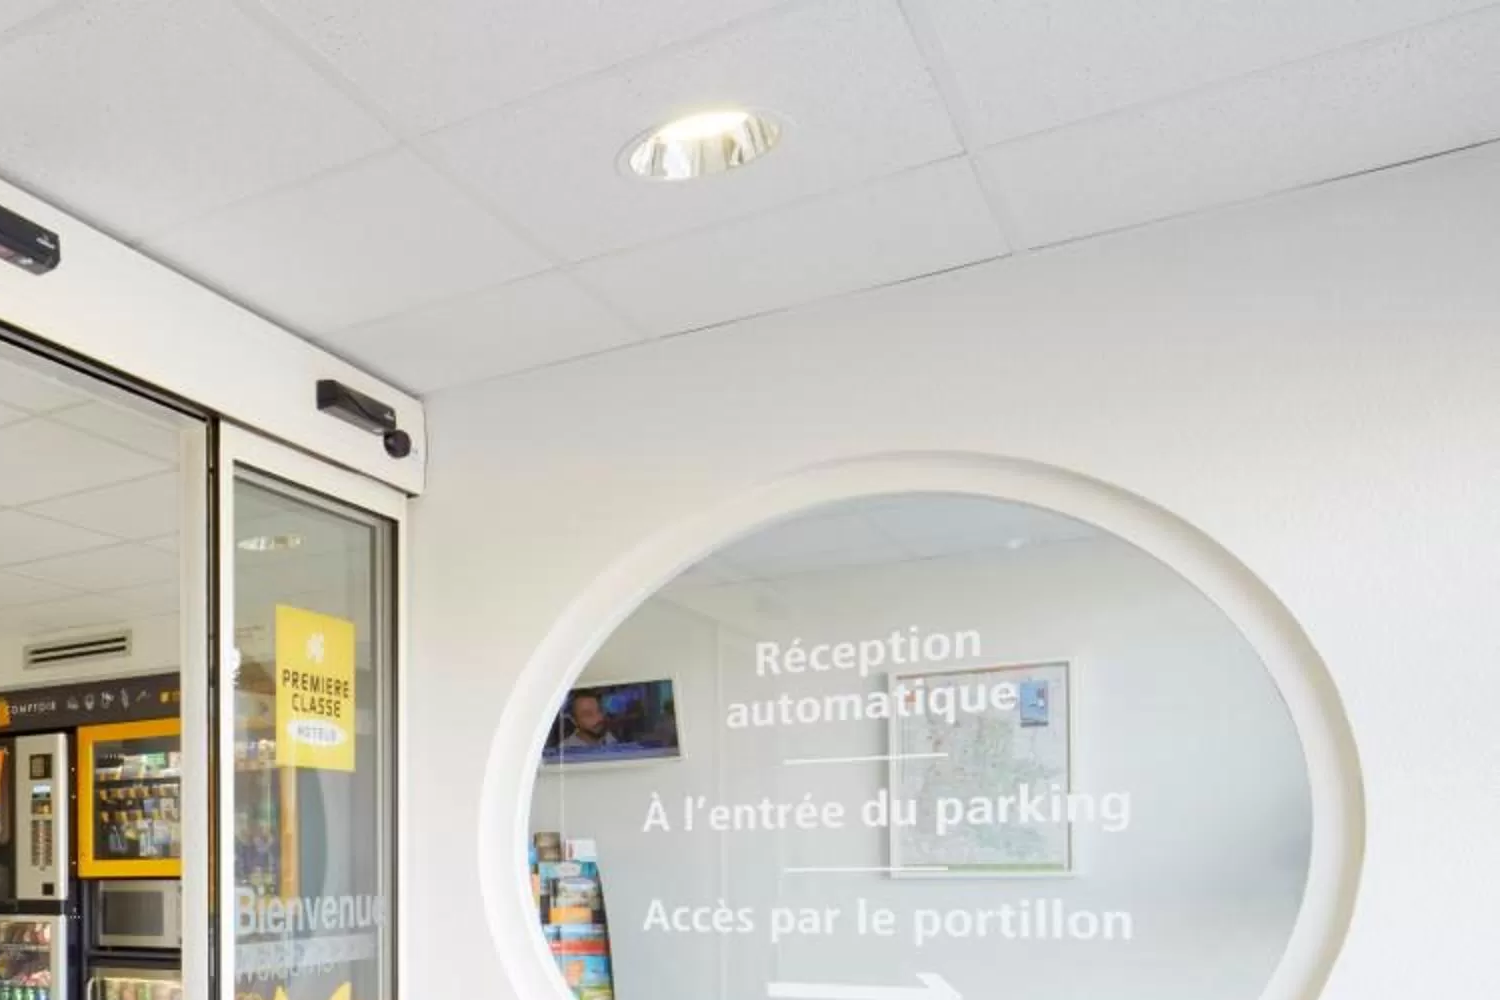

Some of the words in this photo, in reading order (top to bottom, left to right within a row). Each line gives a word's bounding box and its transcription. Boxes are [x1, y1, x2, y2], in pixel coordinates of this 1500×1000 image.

[755, 626, 981, 678] Réception
[282, 669, 349, 699] PREMIERE
[291, 693, 341, 719] CLASSE
[726, 677, 1018, 729] automatique
[643, 793, 670, 832] À
[861, 789, 917, 828] du
[936, 784, 1132, 836] parking
[235, 885, 386, 936] Bienvenue
[643, 898, 755, 935] Accès
[771, 905, 842, 944] par
[859, 898, 896, 936] le
[915, 898, 1134, 947] portillon
